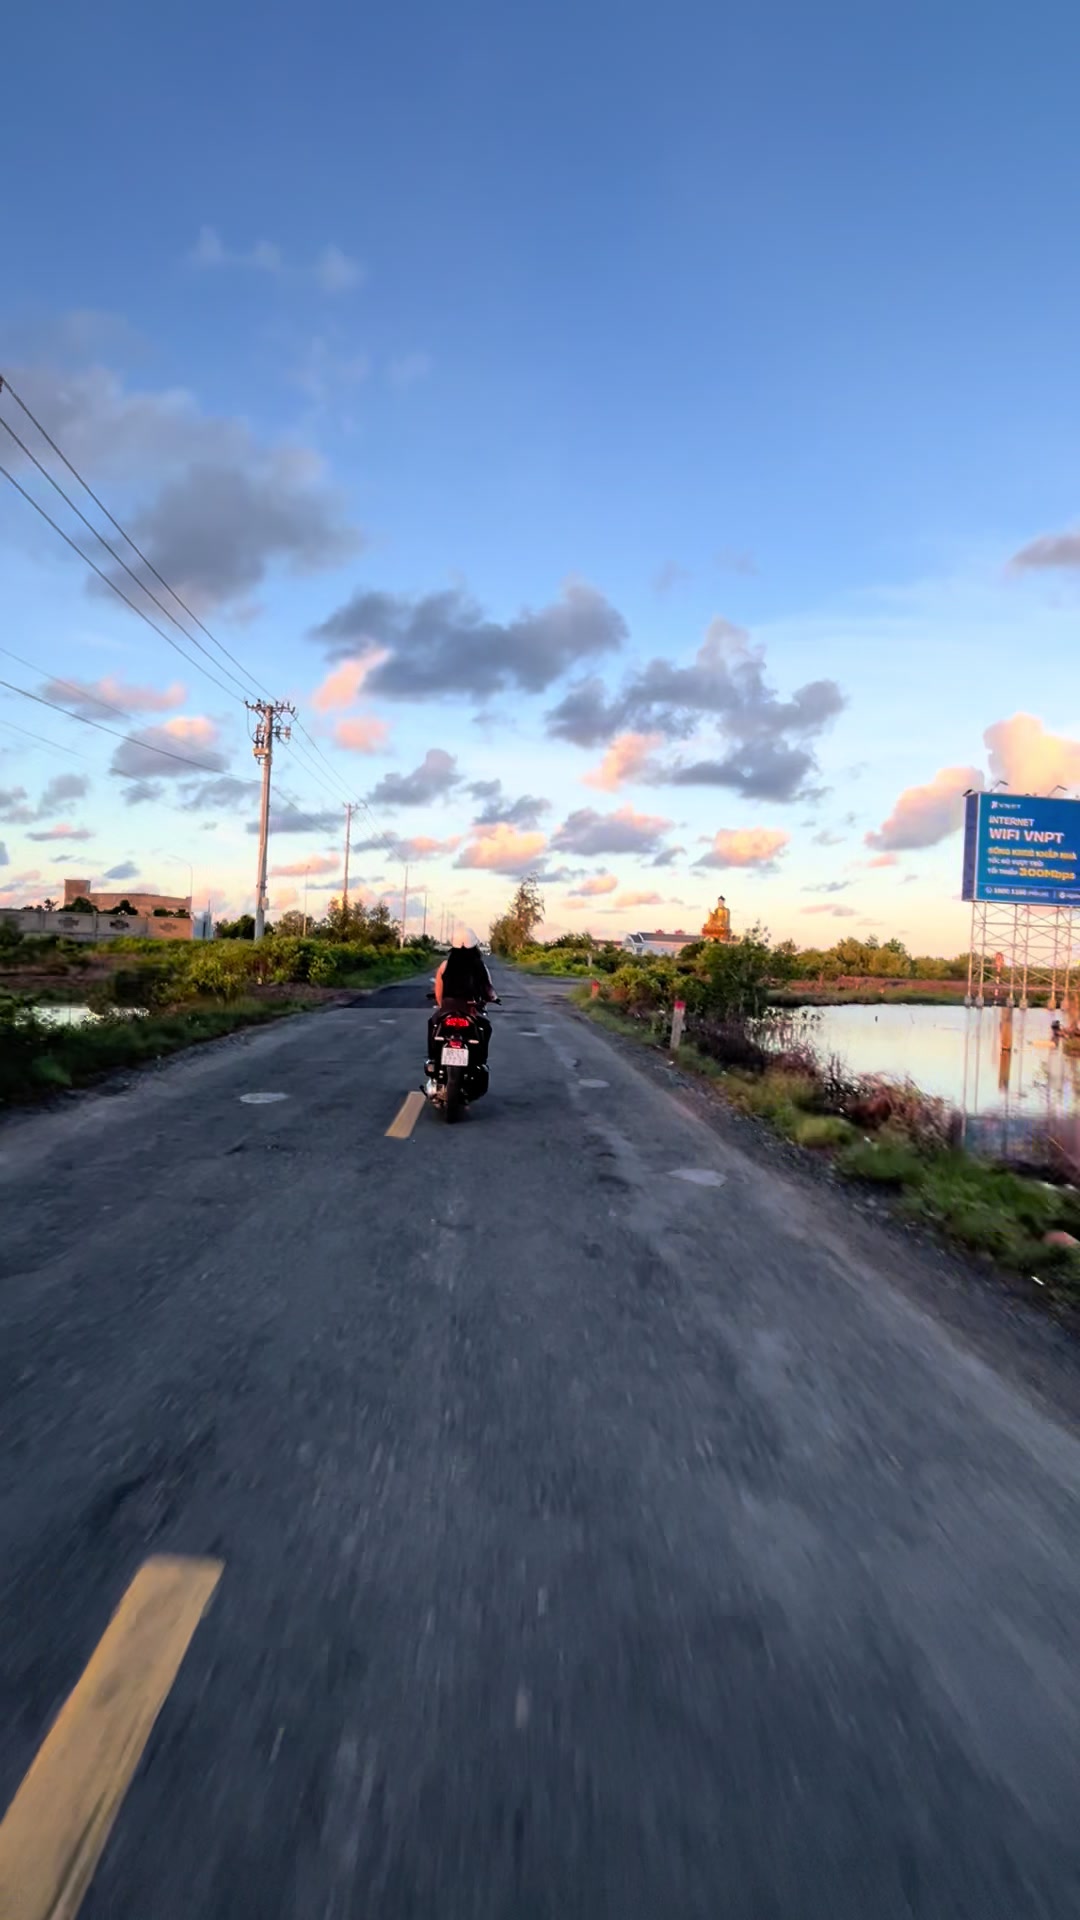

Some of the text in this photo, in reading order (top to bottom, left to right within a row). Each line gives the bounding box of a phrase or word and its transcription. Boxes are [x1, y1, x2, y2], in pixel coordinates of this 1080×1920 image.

[989, 815, 1034, 827] INTERNET
[989, 827, 1064, 844] WIFI VNPT
[1019, 868, 1076, 880] 300Mbps
